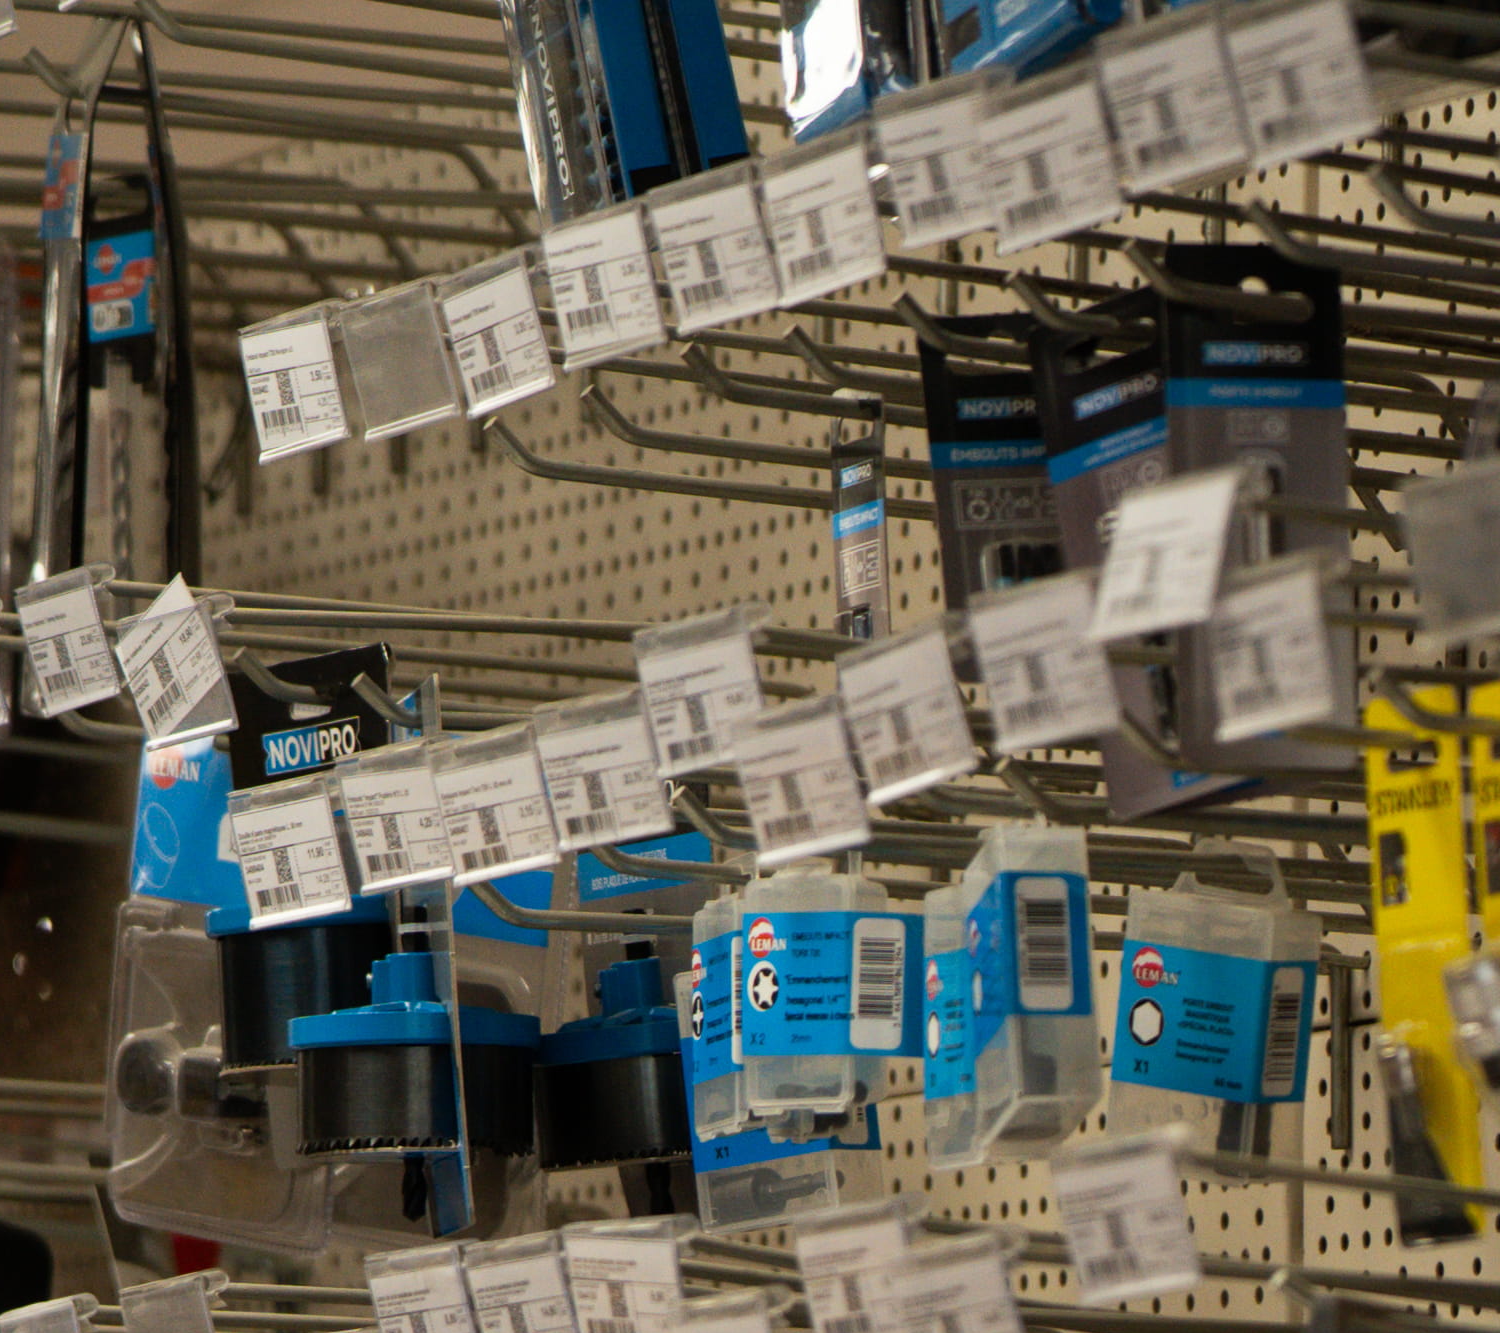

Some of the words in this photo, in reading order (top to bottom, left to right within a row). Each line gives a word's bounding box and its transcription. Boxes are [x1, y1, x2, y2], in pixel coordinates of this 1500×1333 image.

[531, 8, 572, 190] NOVIPRO
[1209, 343, 1302, 364] NOVIPRO
[1078, 374, 1158, 412] NOVIPRO
[963, 399, 1037, 418] NOVIPR
[266, 722, 357, 769] NOVIPRO
[750, 936, 787, 952] LEMAN
[1134, 966, 1179, 986] LEMAN
[1134, 1059, 1149, 1074] X1
[715, 1146, 730, 1160] X1
